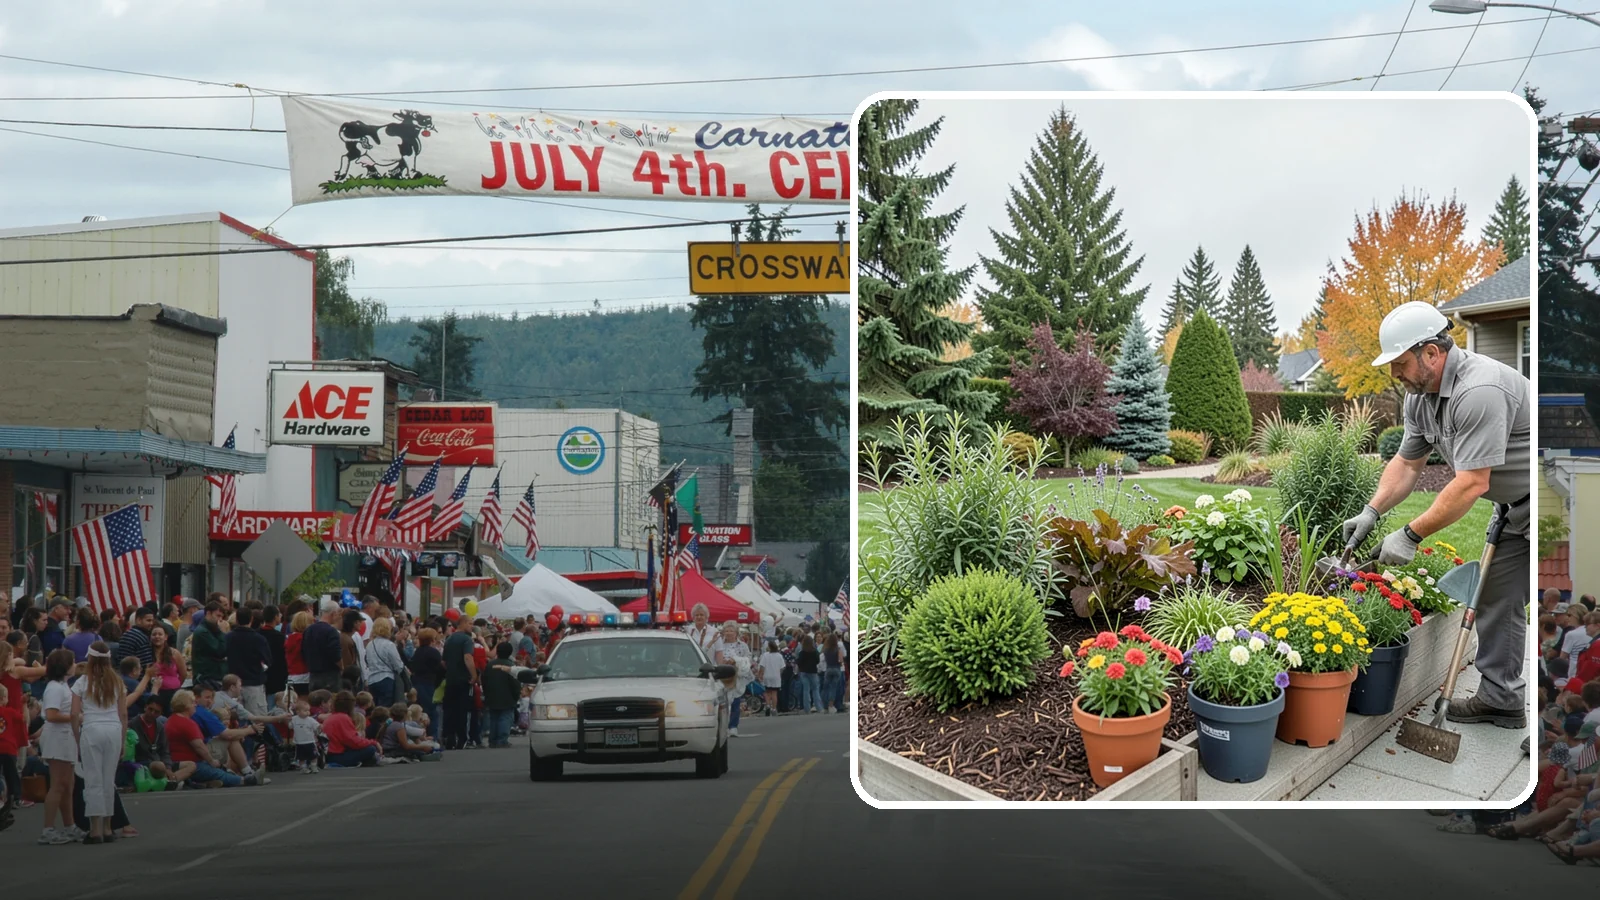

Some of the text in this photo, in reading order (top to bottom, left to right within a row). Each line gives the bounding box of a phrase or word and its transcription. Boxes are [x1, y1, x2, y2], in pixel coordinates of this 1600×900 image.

[481, 141, 605, 193] JULY
[632, 150, 746, 198] 4th.
[697, 254, 850, 280] CROSSWA
[283, 380, 374, 419] ACE
[405, 409, 452, 422] CEDAR
[283, 421, 371, 437] Hardware
[353, 467, 386, 480] Simpl
[95, 485, 124, 494] Vincent
[126, 486, 136, 494] de
[138, 486, 155, 495] Paul
[688, 526, 741, 535] CRNATION
[699, 535, 730, 543] GLASS
